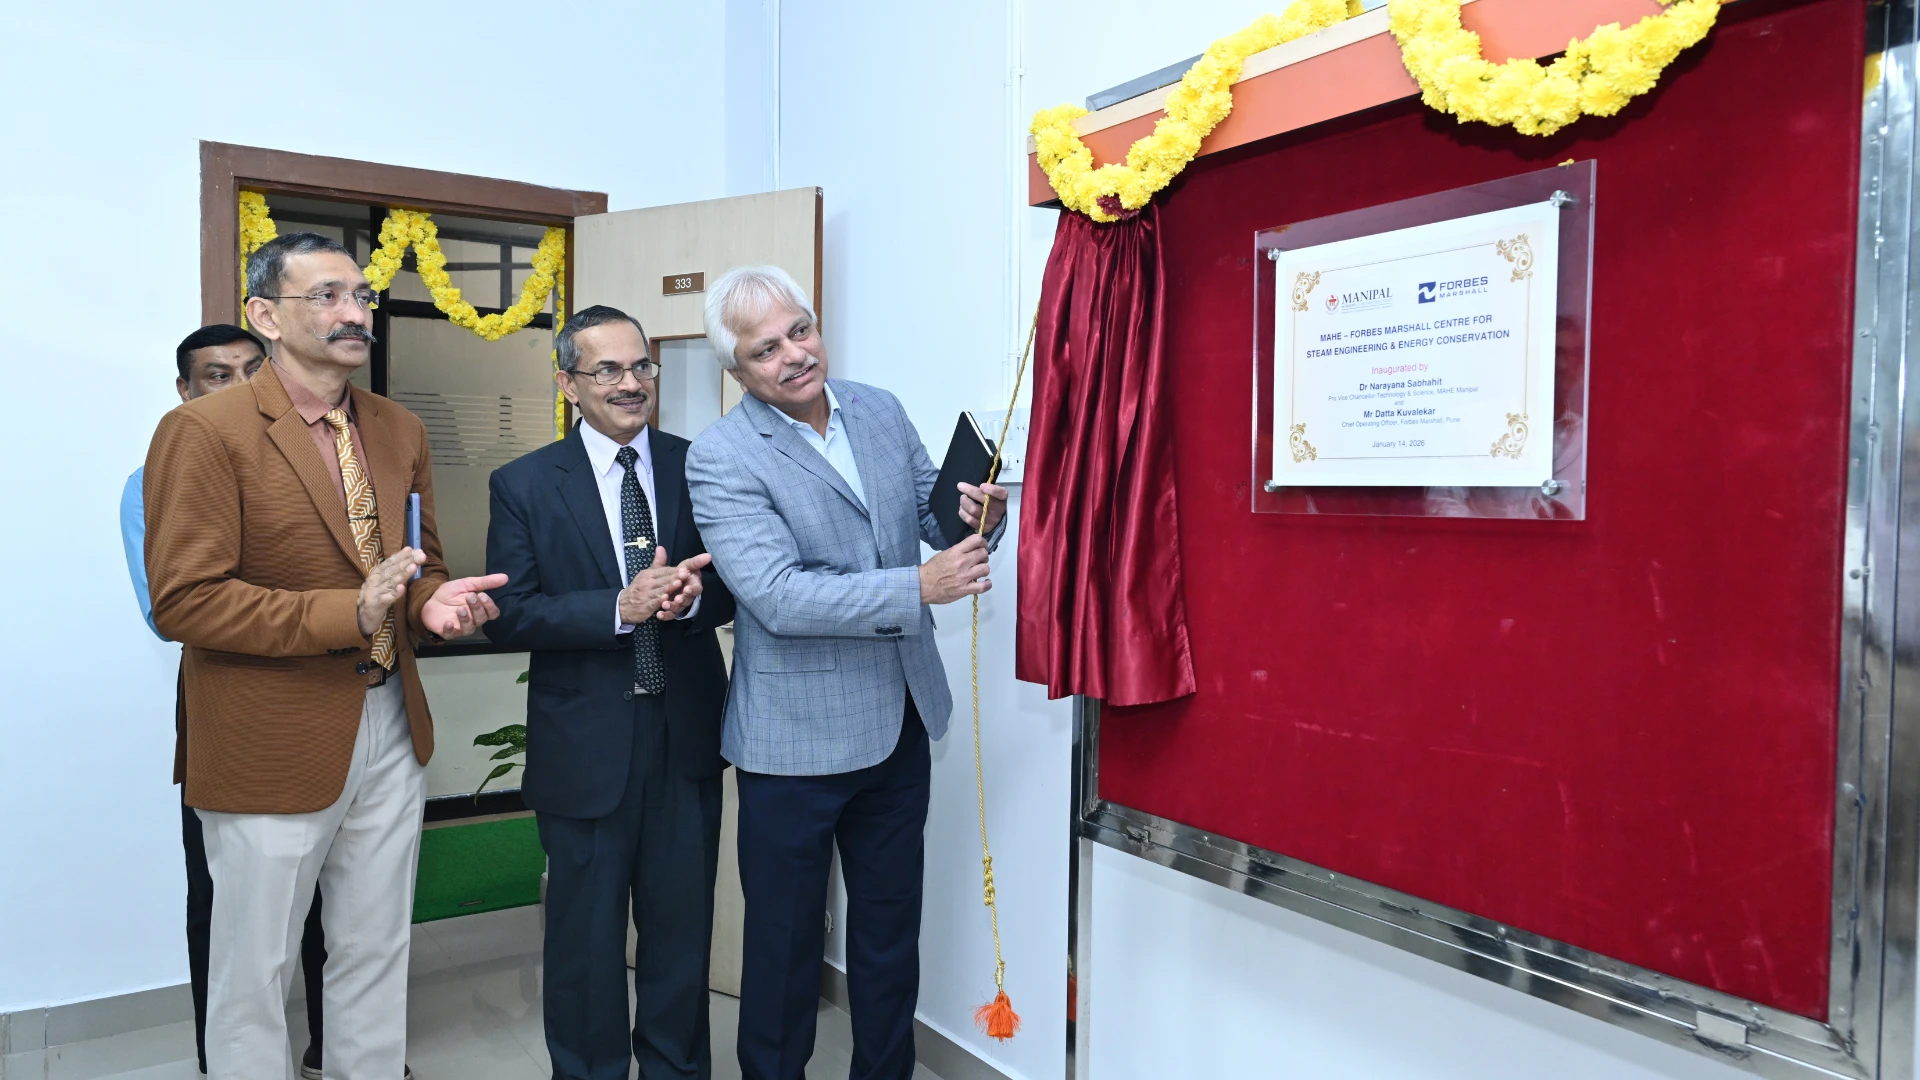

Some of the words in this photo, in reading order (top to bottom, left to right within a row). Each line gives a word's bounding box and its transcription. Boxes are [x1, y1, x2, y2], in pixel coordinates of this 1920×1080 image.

[675, 277, 692, 289] 333
[1440, 276, 1488, 291] FORBES
[1342, 287, 1392, 304] MANIPAL
[1440, 287, 1488, 298] MARSHALL
[1320, 332, 1341, 342] MAHE
[1350, 327, 1382, 338] FORBES
[1384, 322, 1431, 334] MARSHALL
[1434, 316, 1470, 329] CENTRE
[1473, 314, 1492, 324] FOR
[1306, 348, 1332, 358] STEAM
[1334, 342, 1388, 355] ENGINEERING
[1390, 341, 1395, 350] &
[1398, 337, 1434, 348] ENERGY
[1436, 329, 1510, 345] CONSERVATION
[1372, 363, 1417, 375] Inaugurated
[1419, 363, 1428, 372] by
[1359, 383, 1368, 391] Dr
[1370, 382, 1405, 391] Narayana
[1407, 378, 1442, 388] Sabhahit
[1456, 386, 1479, 394] Manipal
[1363, 410, 1373, 418] Mr
[1375, 409, 1395, 418] Datta
[1396, 407, 1436, 417] Kuvalekar
[1355, 420, 1380, 428] Operating
[1398, 440, 1408, 448] 14,
[1409, 439, 1425, 447] 2026
